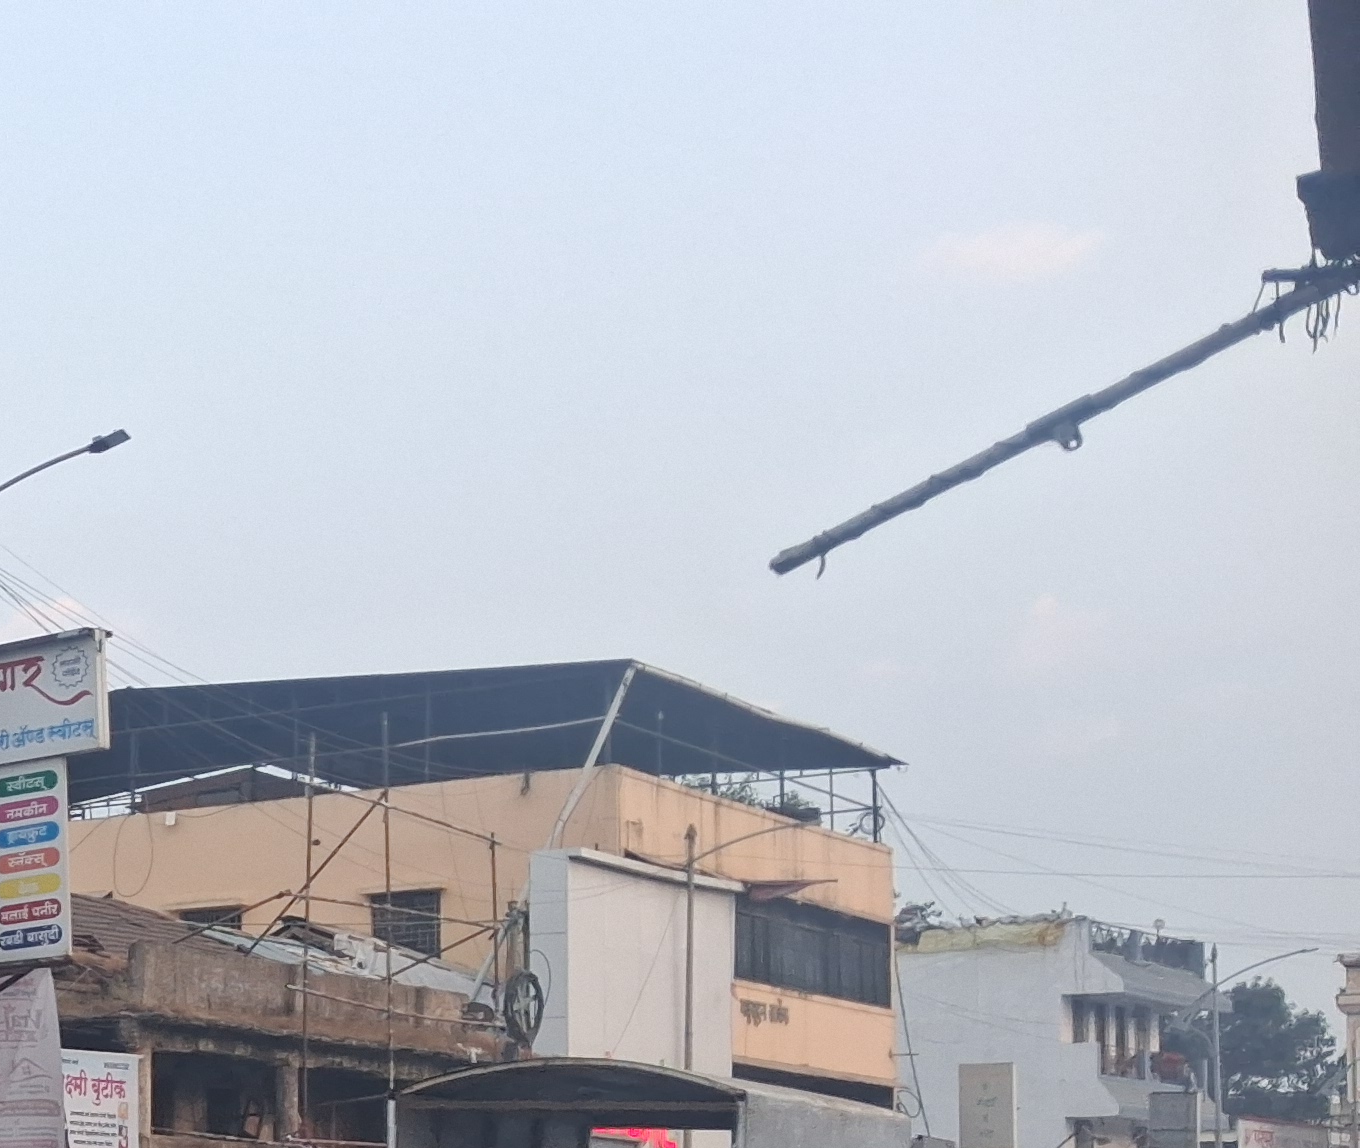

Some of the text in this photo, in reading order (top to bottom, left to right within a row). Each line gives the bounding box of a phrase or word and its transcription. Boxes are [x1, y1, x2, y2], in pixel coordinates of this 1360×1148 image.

[5, 801, 48, 820] नमकीन
[0, 901, 58, 922] मलाई पनीर
[91, 1071, 127, 1106] बुटीक
